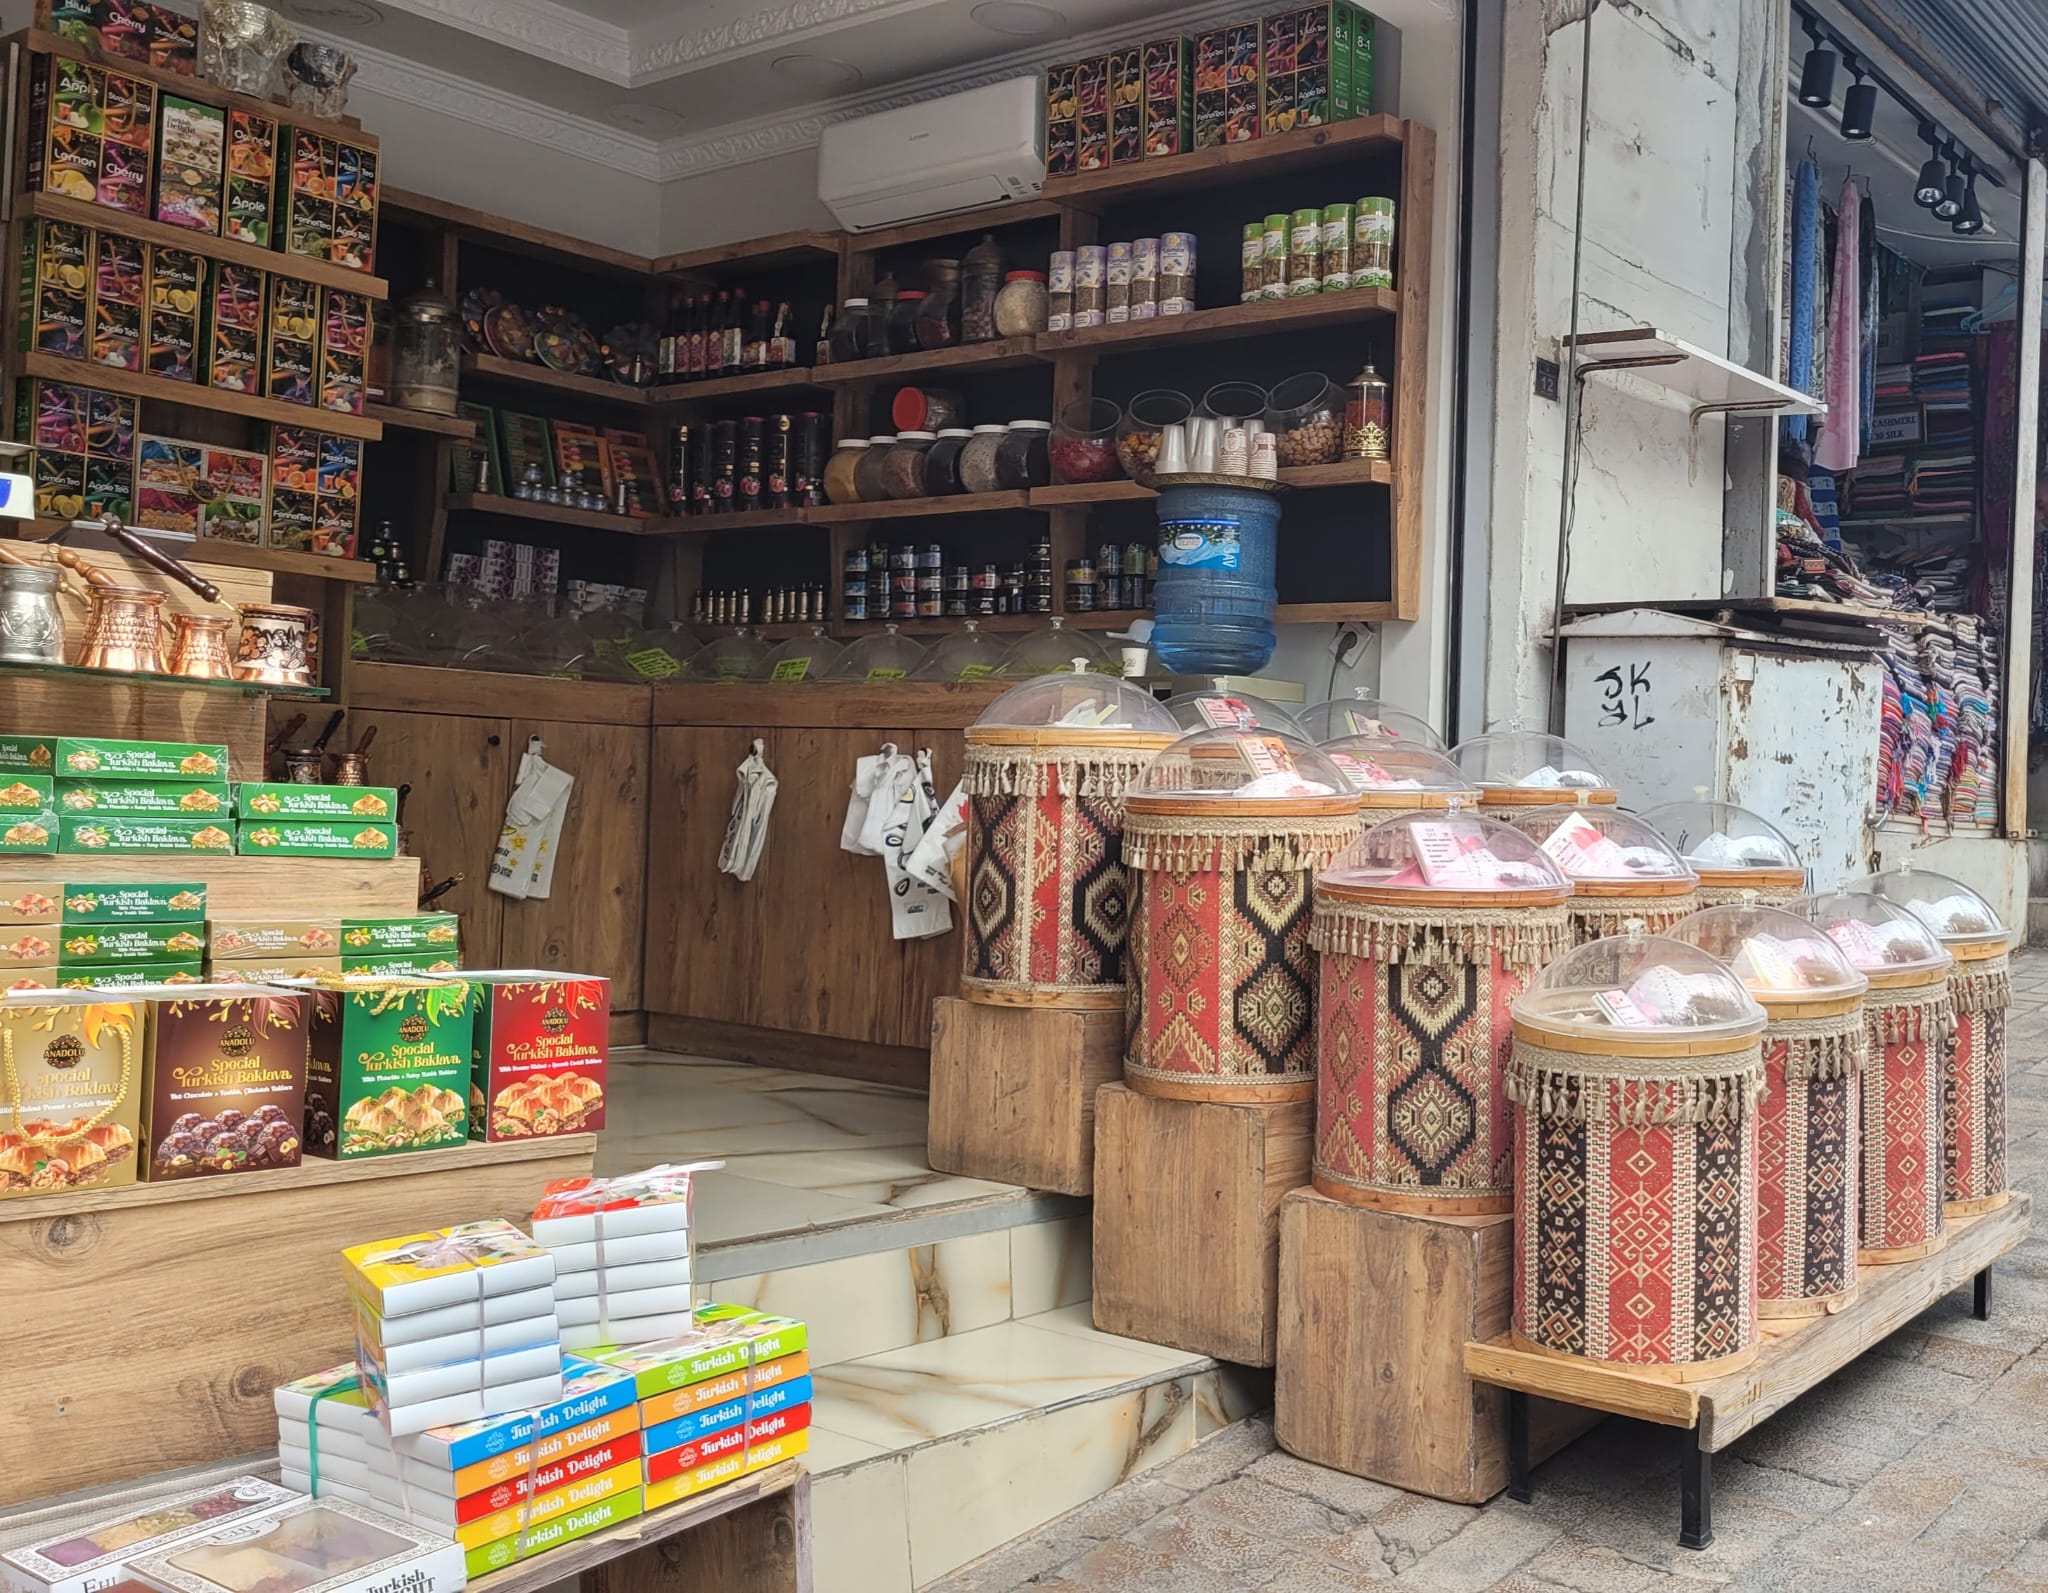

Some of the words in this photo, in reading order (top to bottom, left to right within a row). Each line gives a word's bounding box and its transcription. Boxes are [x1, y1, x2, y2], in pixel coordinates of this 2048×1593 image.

[54, 148, 97, 169] Lemon
[106, 163, 144, 183] Cherry
[232, 196, 266, 212] Apple
[88, 481, 114, 492] Apple
[105, 752, 140, 766] Turkish
[142, 760, 176, 768] Baklava
[126, 751, 156, 760] Special
[102, 791, 138, 804] Turkish
[140, 797, 175, 805] Baklava
[124, 788, 154, 797] Special
[303, 793, 331, 802] Special
[284, 796, 316, 809] Turkish
[318, 801, 349, 810] Baklava
[114, 829, 151, 842] Turkish
[152, 835, 187, 843] Baklava
[136, 826, 167, 835] Special
[284, 830, 316, 842] Turkish
[318, 836, 349, 844] Baklava
[304, 827, 331, 835] Special
[98, 894, 133, 906] Turkish
[134, 898, 168, 906] Baklava
[119, 890, 149, 899] Special
[98, 935, 132, 947] Turkish
[133, 939, 167, 947] Baklava
[119, 932, 148, 940] Special
[399, 1025, 429, 1034] ANADOLU
[219, 1038, 255, 1047] ANADOLU
[536, 1033, 573, 1049] Special
[44, 1047, 85, 1058] ANADOLU
[391, 1042, 435, 1059] Special
[506, 1043, 553, 1061] Turkish
[555, 1046, 598, 1058] Baklava
[211, 1056, 260, 1074] Special
[358, 1051, 411, 1072] Turkish
[414, 1054, 461, 1070] Baklava
[37, 1068, 92, 1086] Special
[172, 1066, 235, 1088] Turkish
[237, 1068, 293, 1084] Baklava
[691, 1352, 736, 1374] Turkish
[696, 1379, 739, 1402] Turkish
[562, 1394, 608, 1421] Delight
[700, 1405, 742, 1428] Turkish
[565, 1420, 610, 1447] Delight
[701, 1432, 743, 1456] Turkish
[567, 1448, 612, 1476] Delight
[696, 1460, 739, 1484] Turkish
[568, 1477, 613, 1504] Delight
[566, 1505, 612, 1532] Delight
